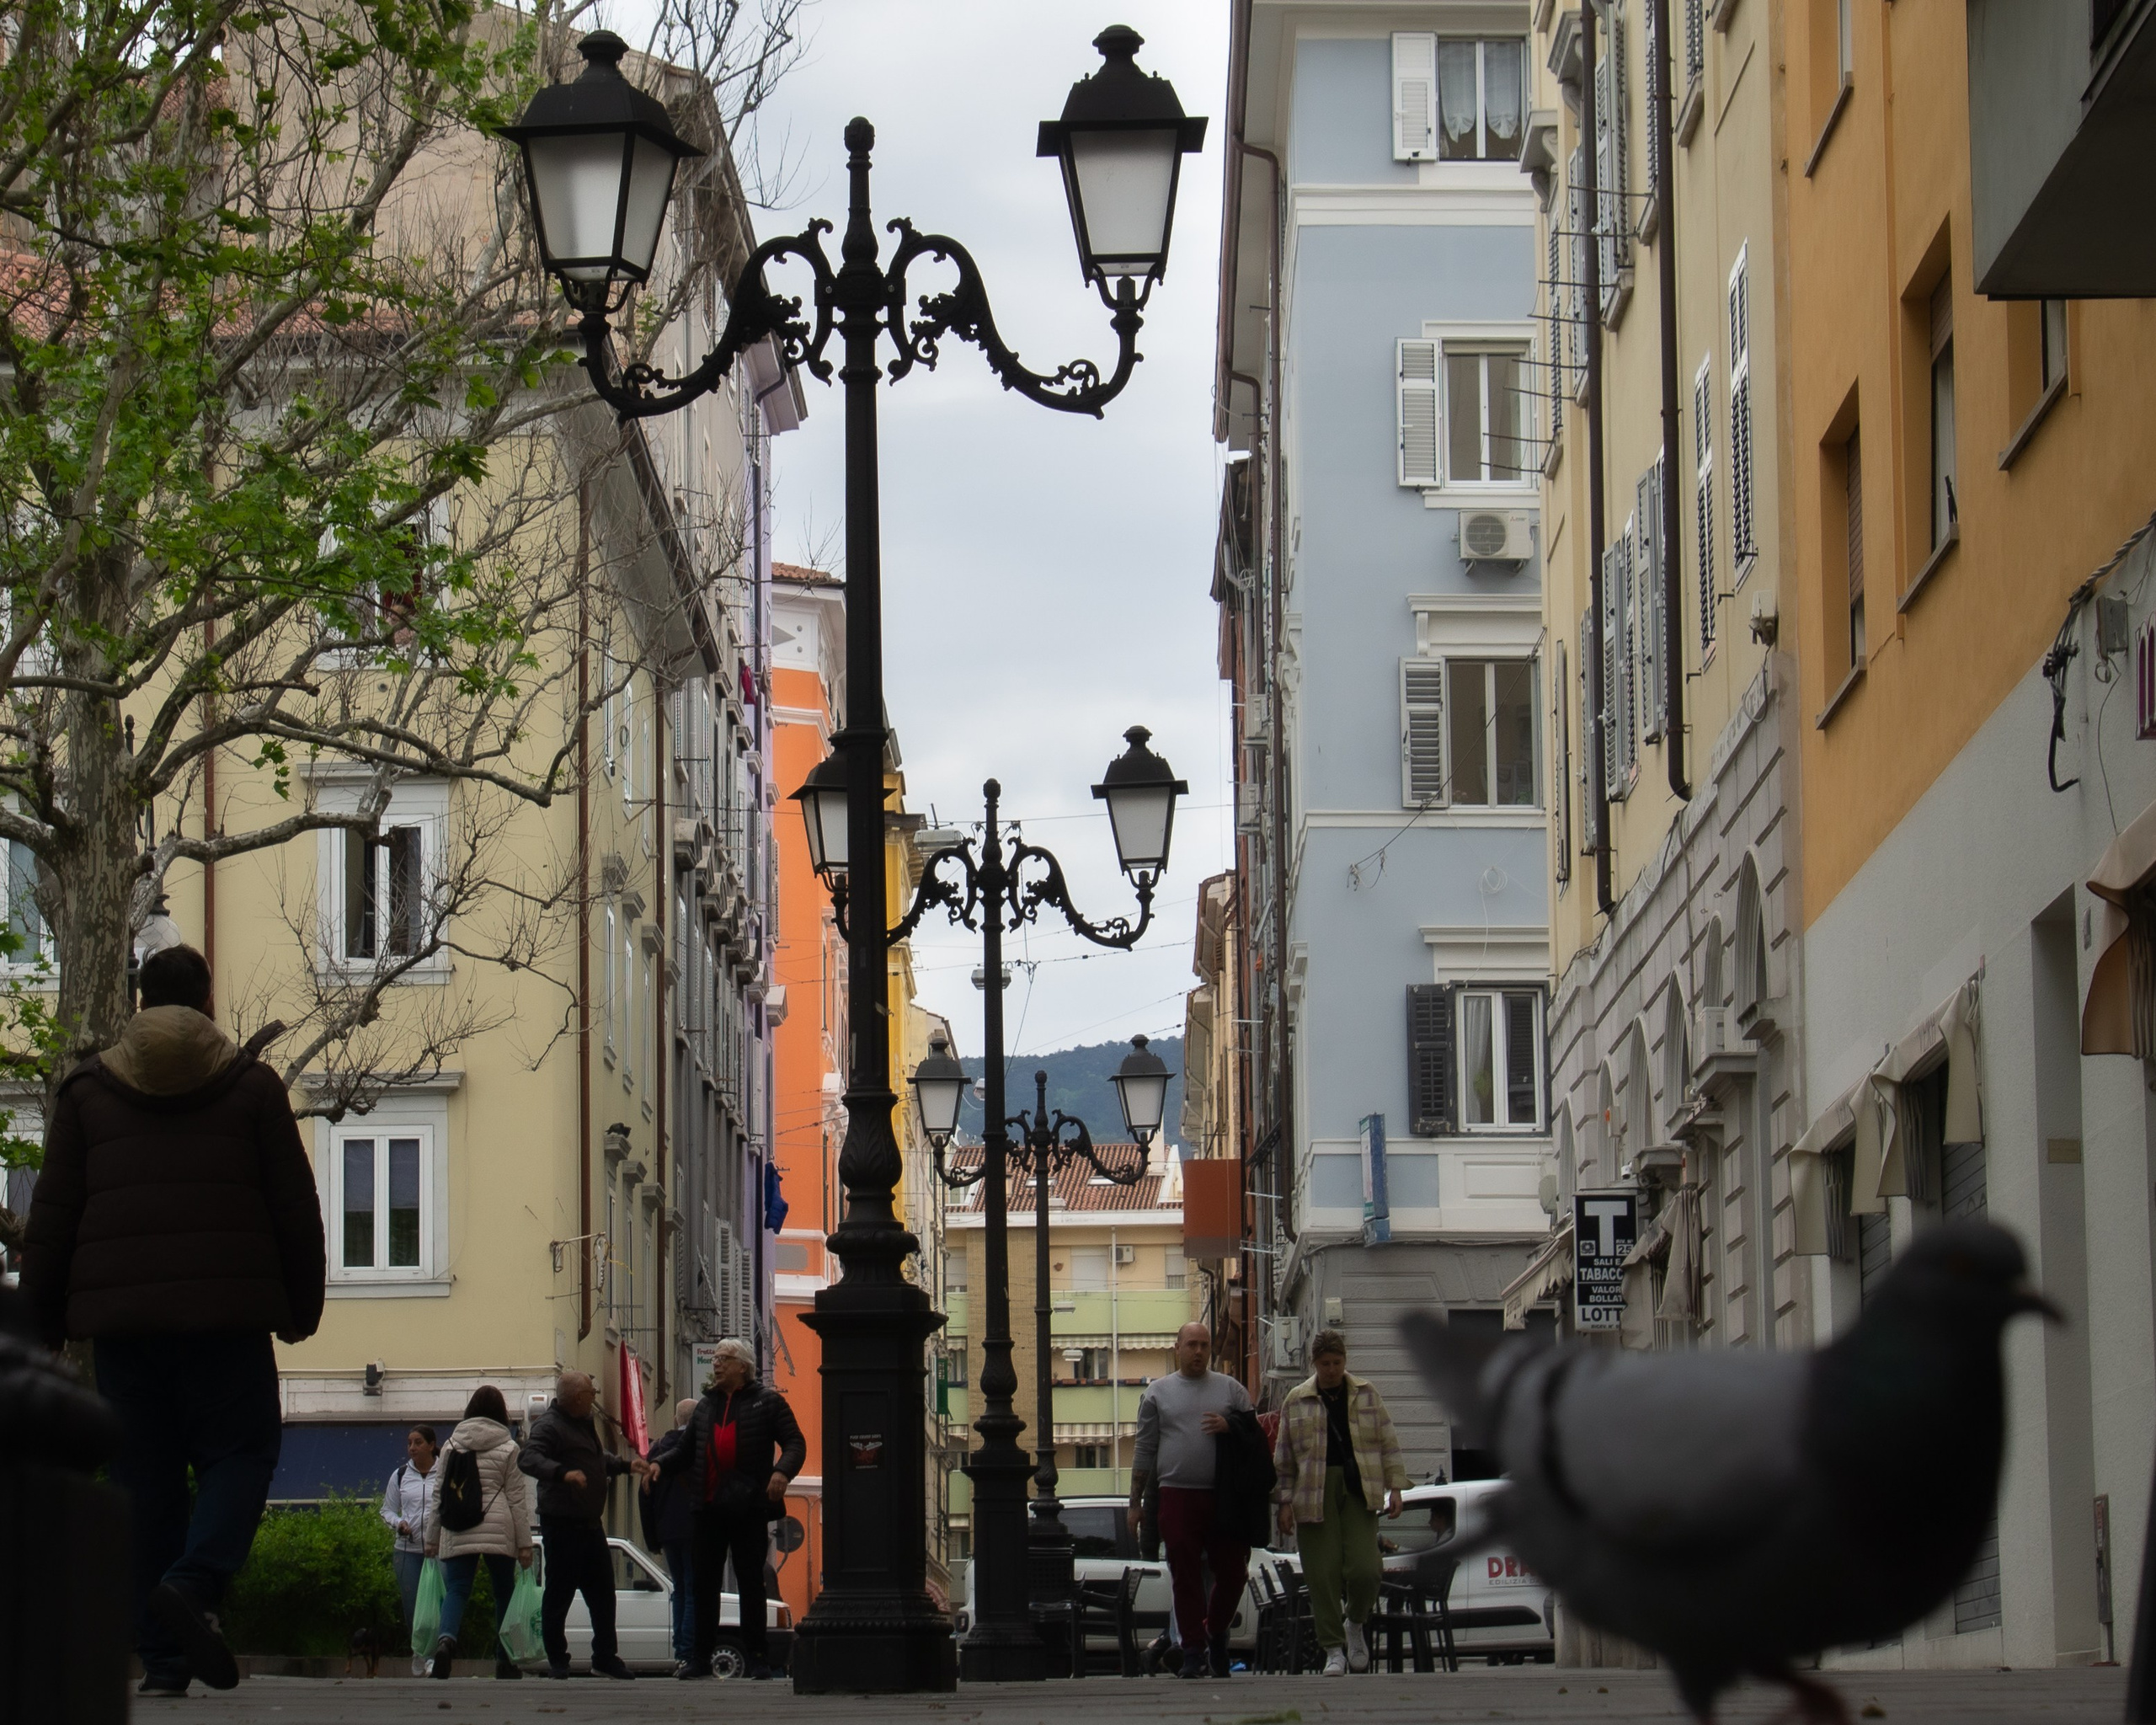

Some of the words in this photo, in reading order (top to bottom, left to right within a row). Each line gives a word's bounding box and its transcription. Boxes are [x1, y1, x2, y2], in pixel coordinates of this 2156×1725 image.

[1584, 1201, 1627, 1256] T
[1579, 1268, 1624, 1281] TABACC
[1592, 1285, 1621, 1294] VALOR
[1589, 1295, 1623, 1303] BOLLAT
[1582, 1307, 1622, 1322] LOTT
[1487, 1556, 1536, 1578] DRA
